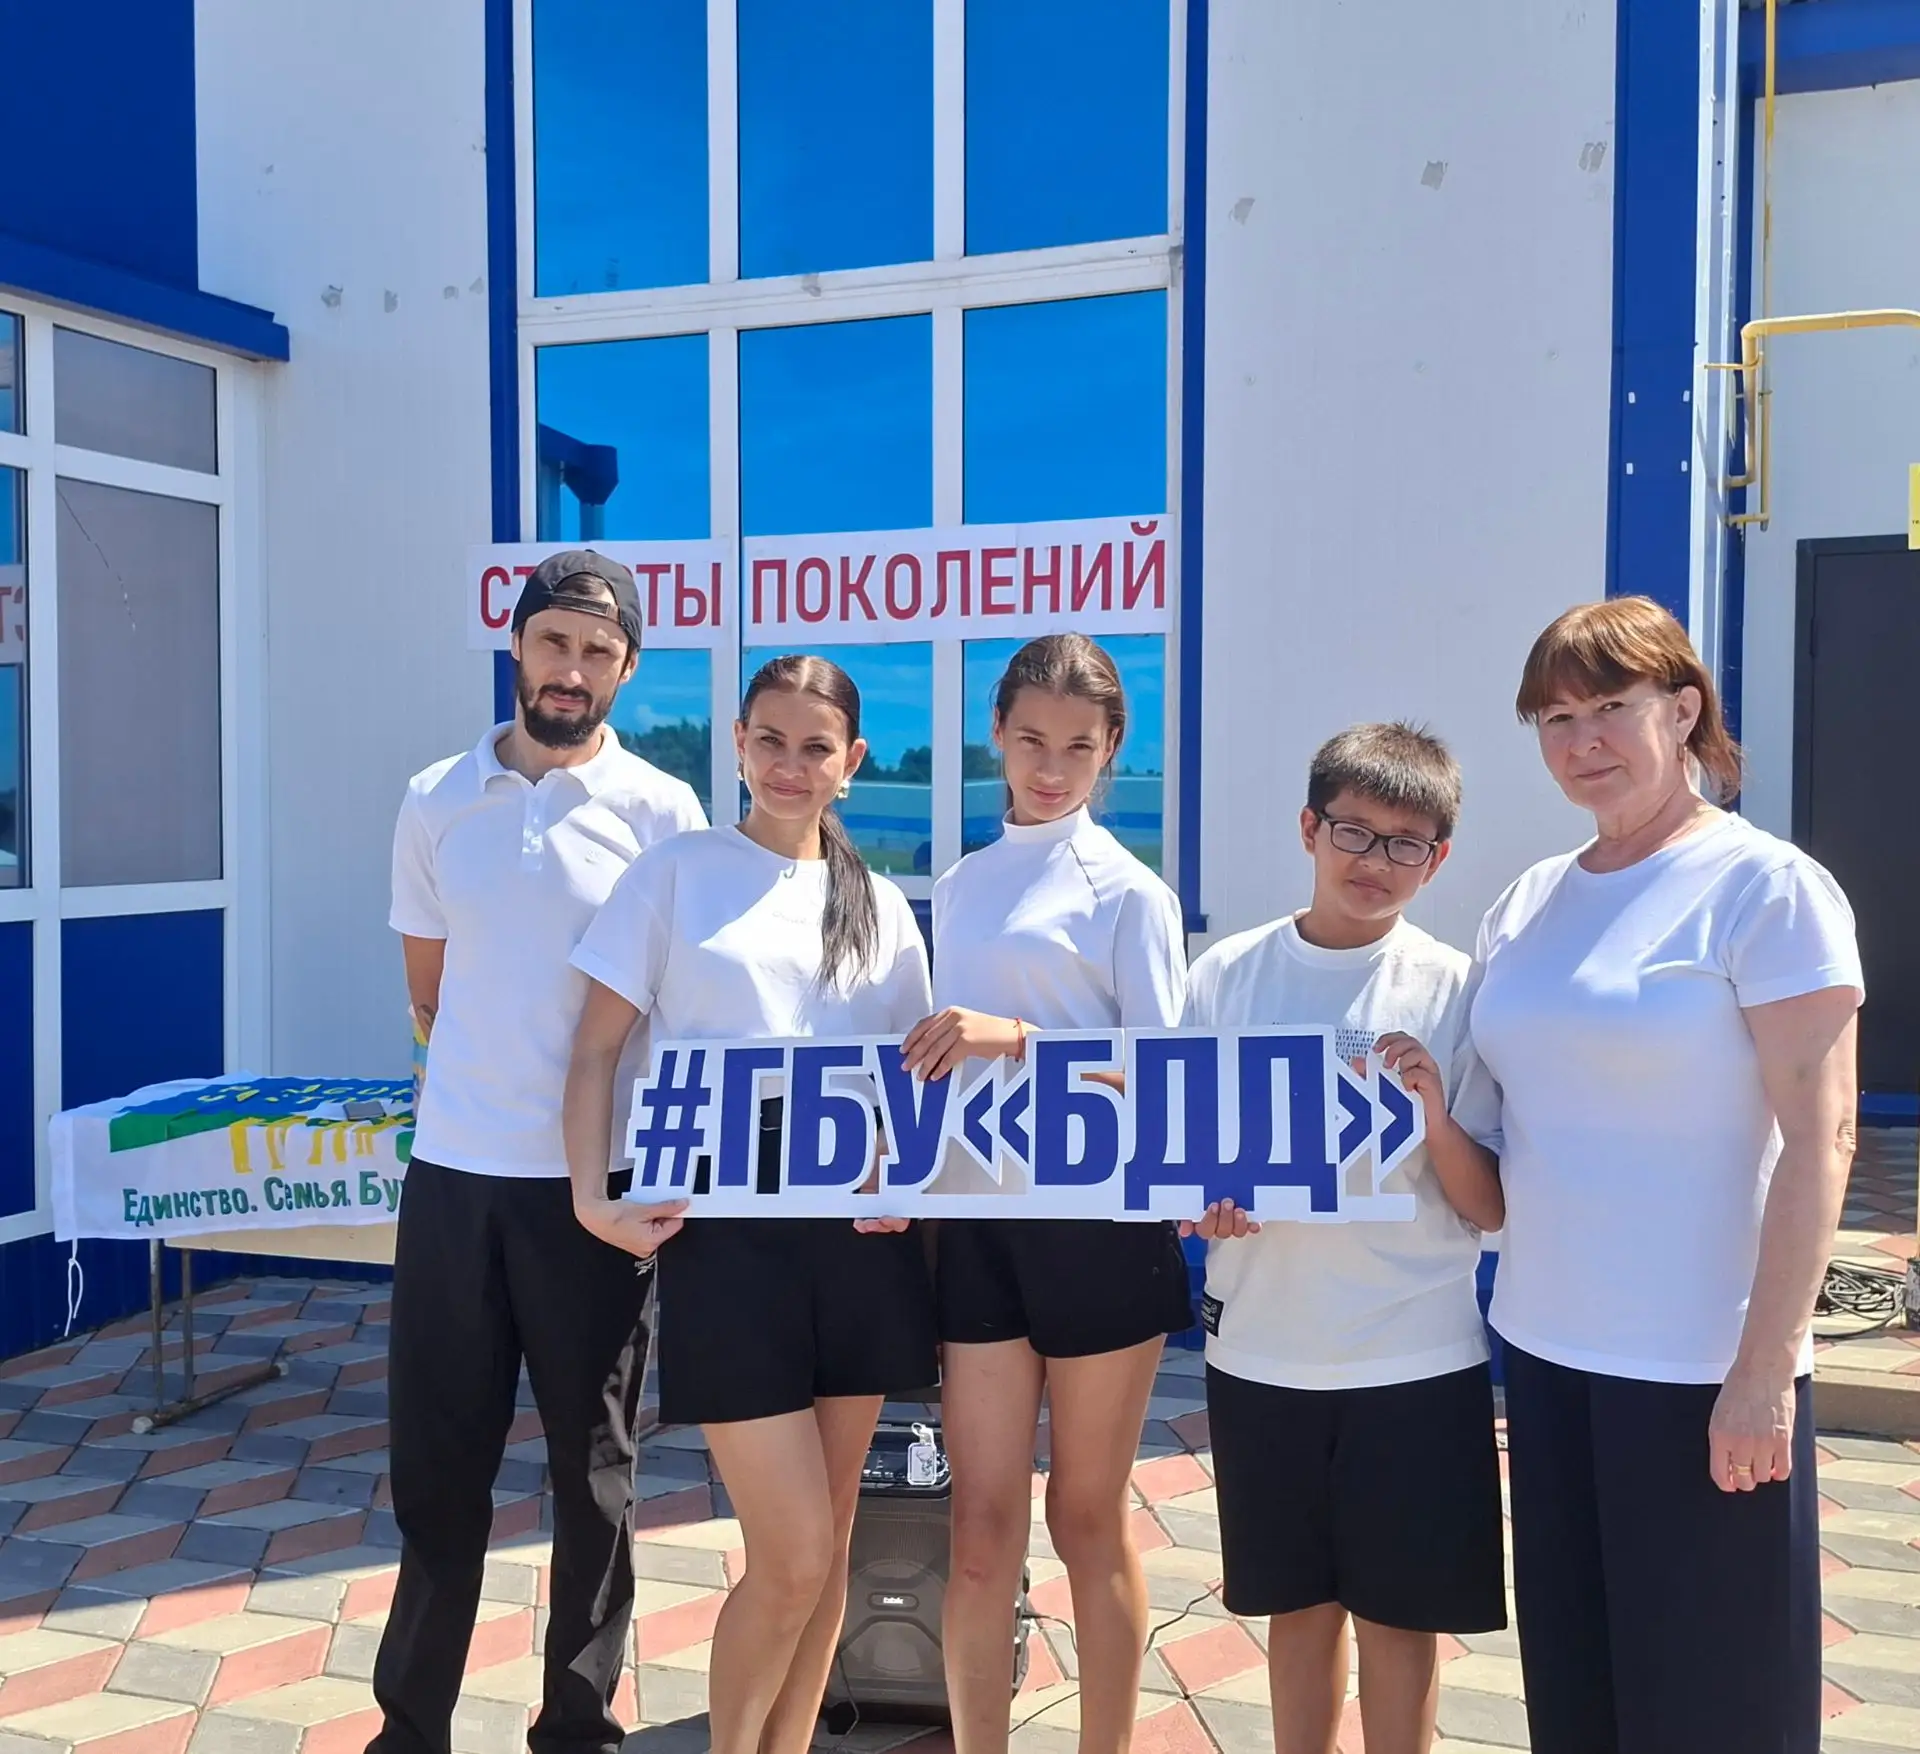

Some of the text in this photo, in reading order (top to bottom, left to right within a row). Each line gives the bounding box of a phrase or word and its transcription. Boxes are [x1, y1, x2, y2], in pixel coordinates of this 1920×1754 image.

[480, 522, 1166, 629] СТЫ ПОКОЛЕНИЙ
[122, 1188, 259, 1228] Единство.
[359, 1171, 404, 1213] Бу
